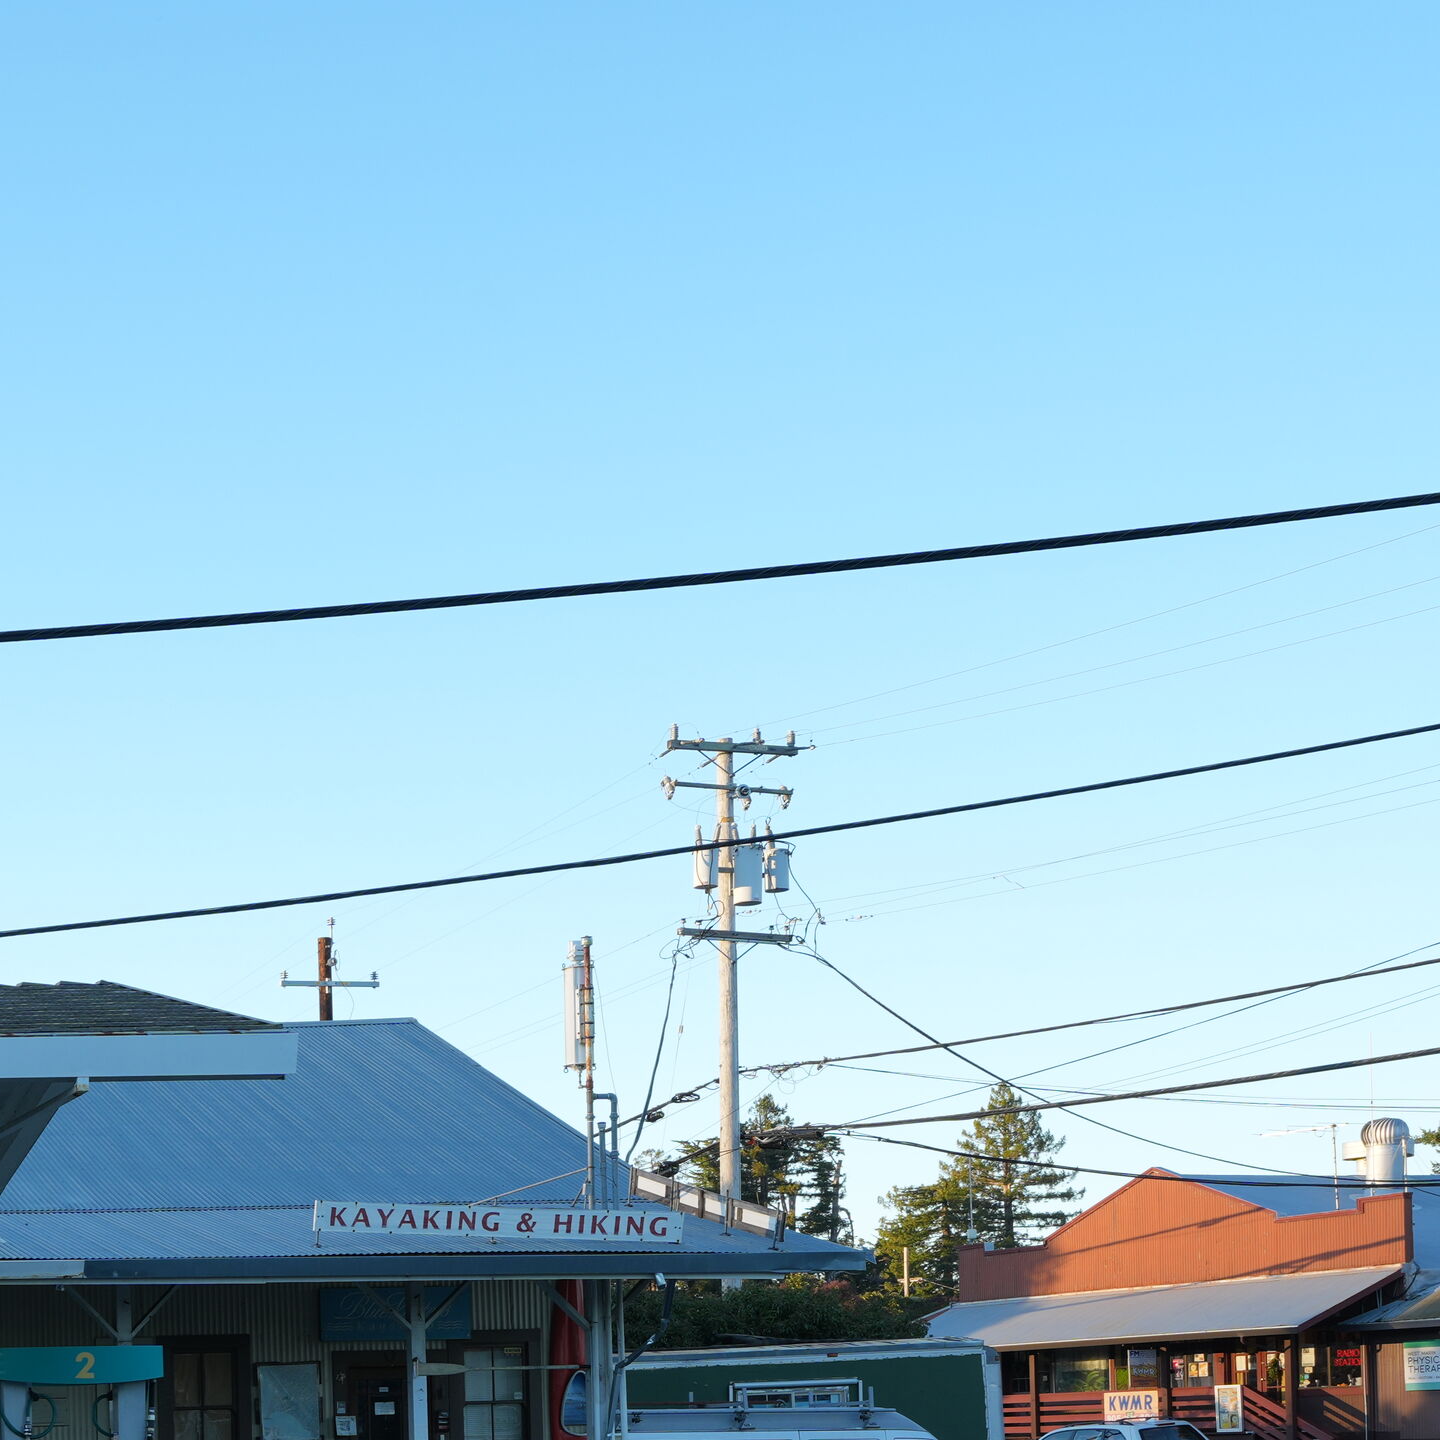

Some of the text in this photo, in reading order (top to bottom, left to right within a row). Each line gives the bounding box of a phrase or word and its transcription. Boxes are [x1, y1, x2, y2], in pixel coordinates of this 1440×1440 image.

[329, 1207, 669, 1237] KAYAKING & HIKING
[1336, 1348, 1361, 1358] RADIO
[74, 1351, 96, 1379] 2
[1109, 1394, 1153, 1411] KWMR
